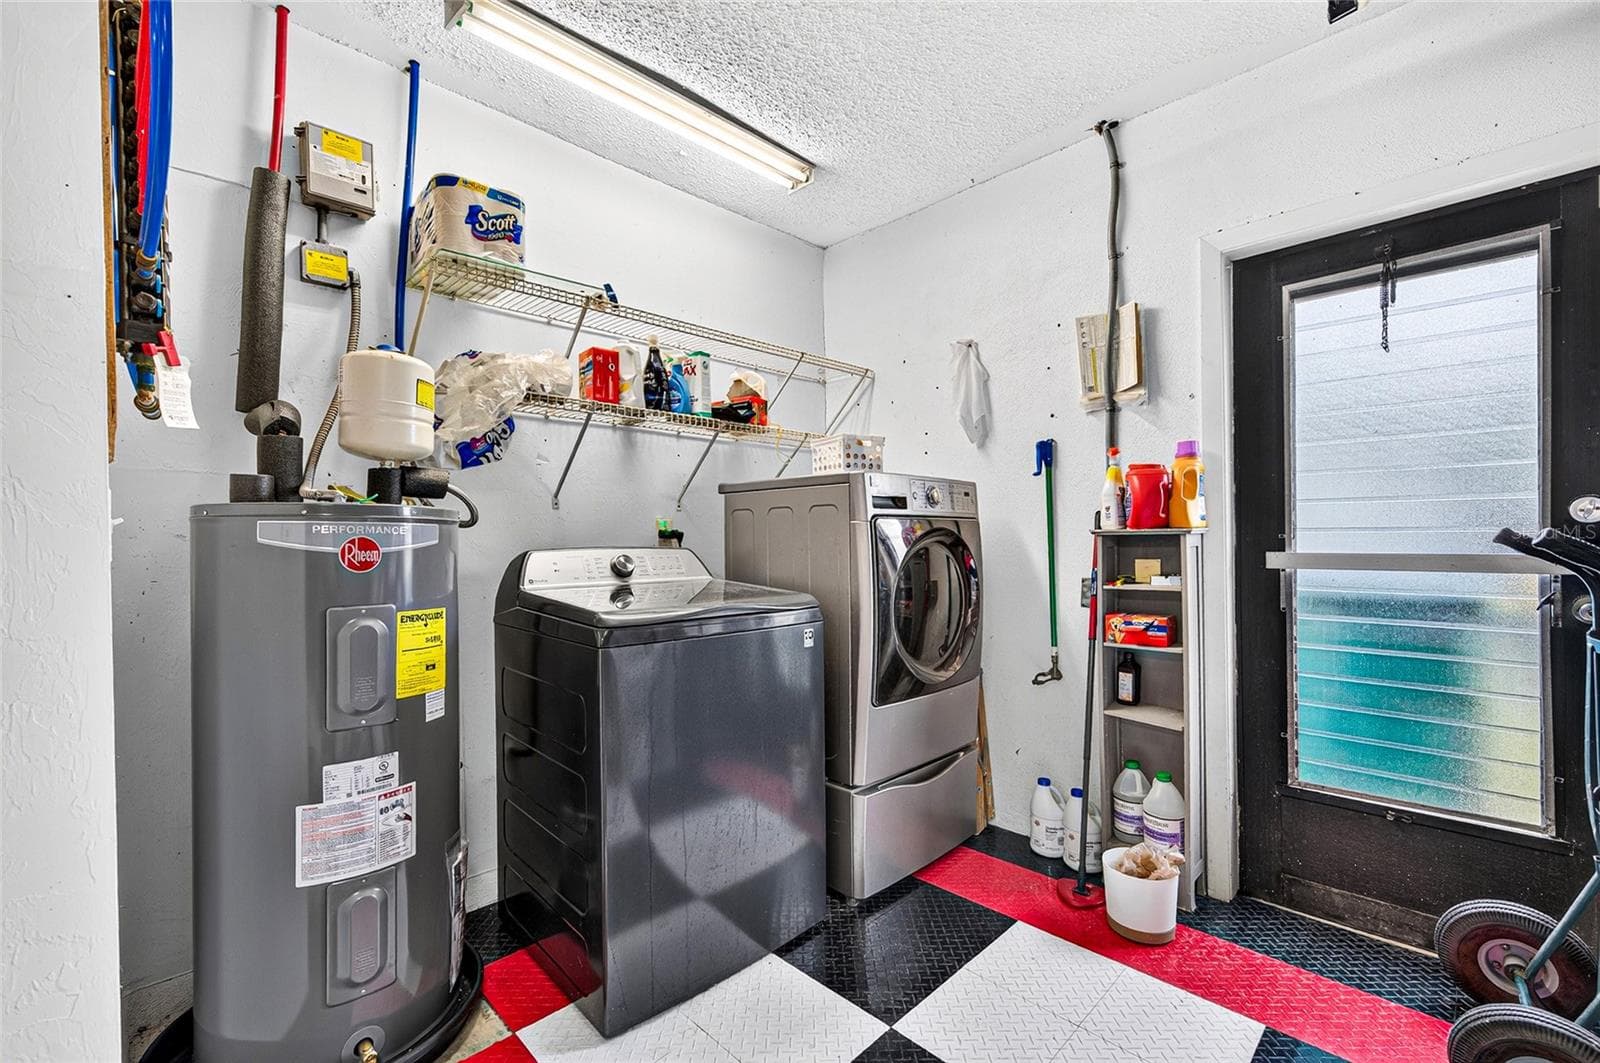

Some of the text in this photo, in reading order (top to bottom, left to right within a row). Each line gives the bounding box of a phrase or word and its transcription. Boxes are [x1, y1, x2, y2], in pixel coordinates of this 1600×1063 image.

[476, 210, 517, 231] Scott
[311, 524, 410, 535] PERFORMANCE
[344, 537, 380, 567] Rheem
